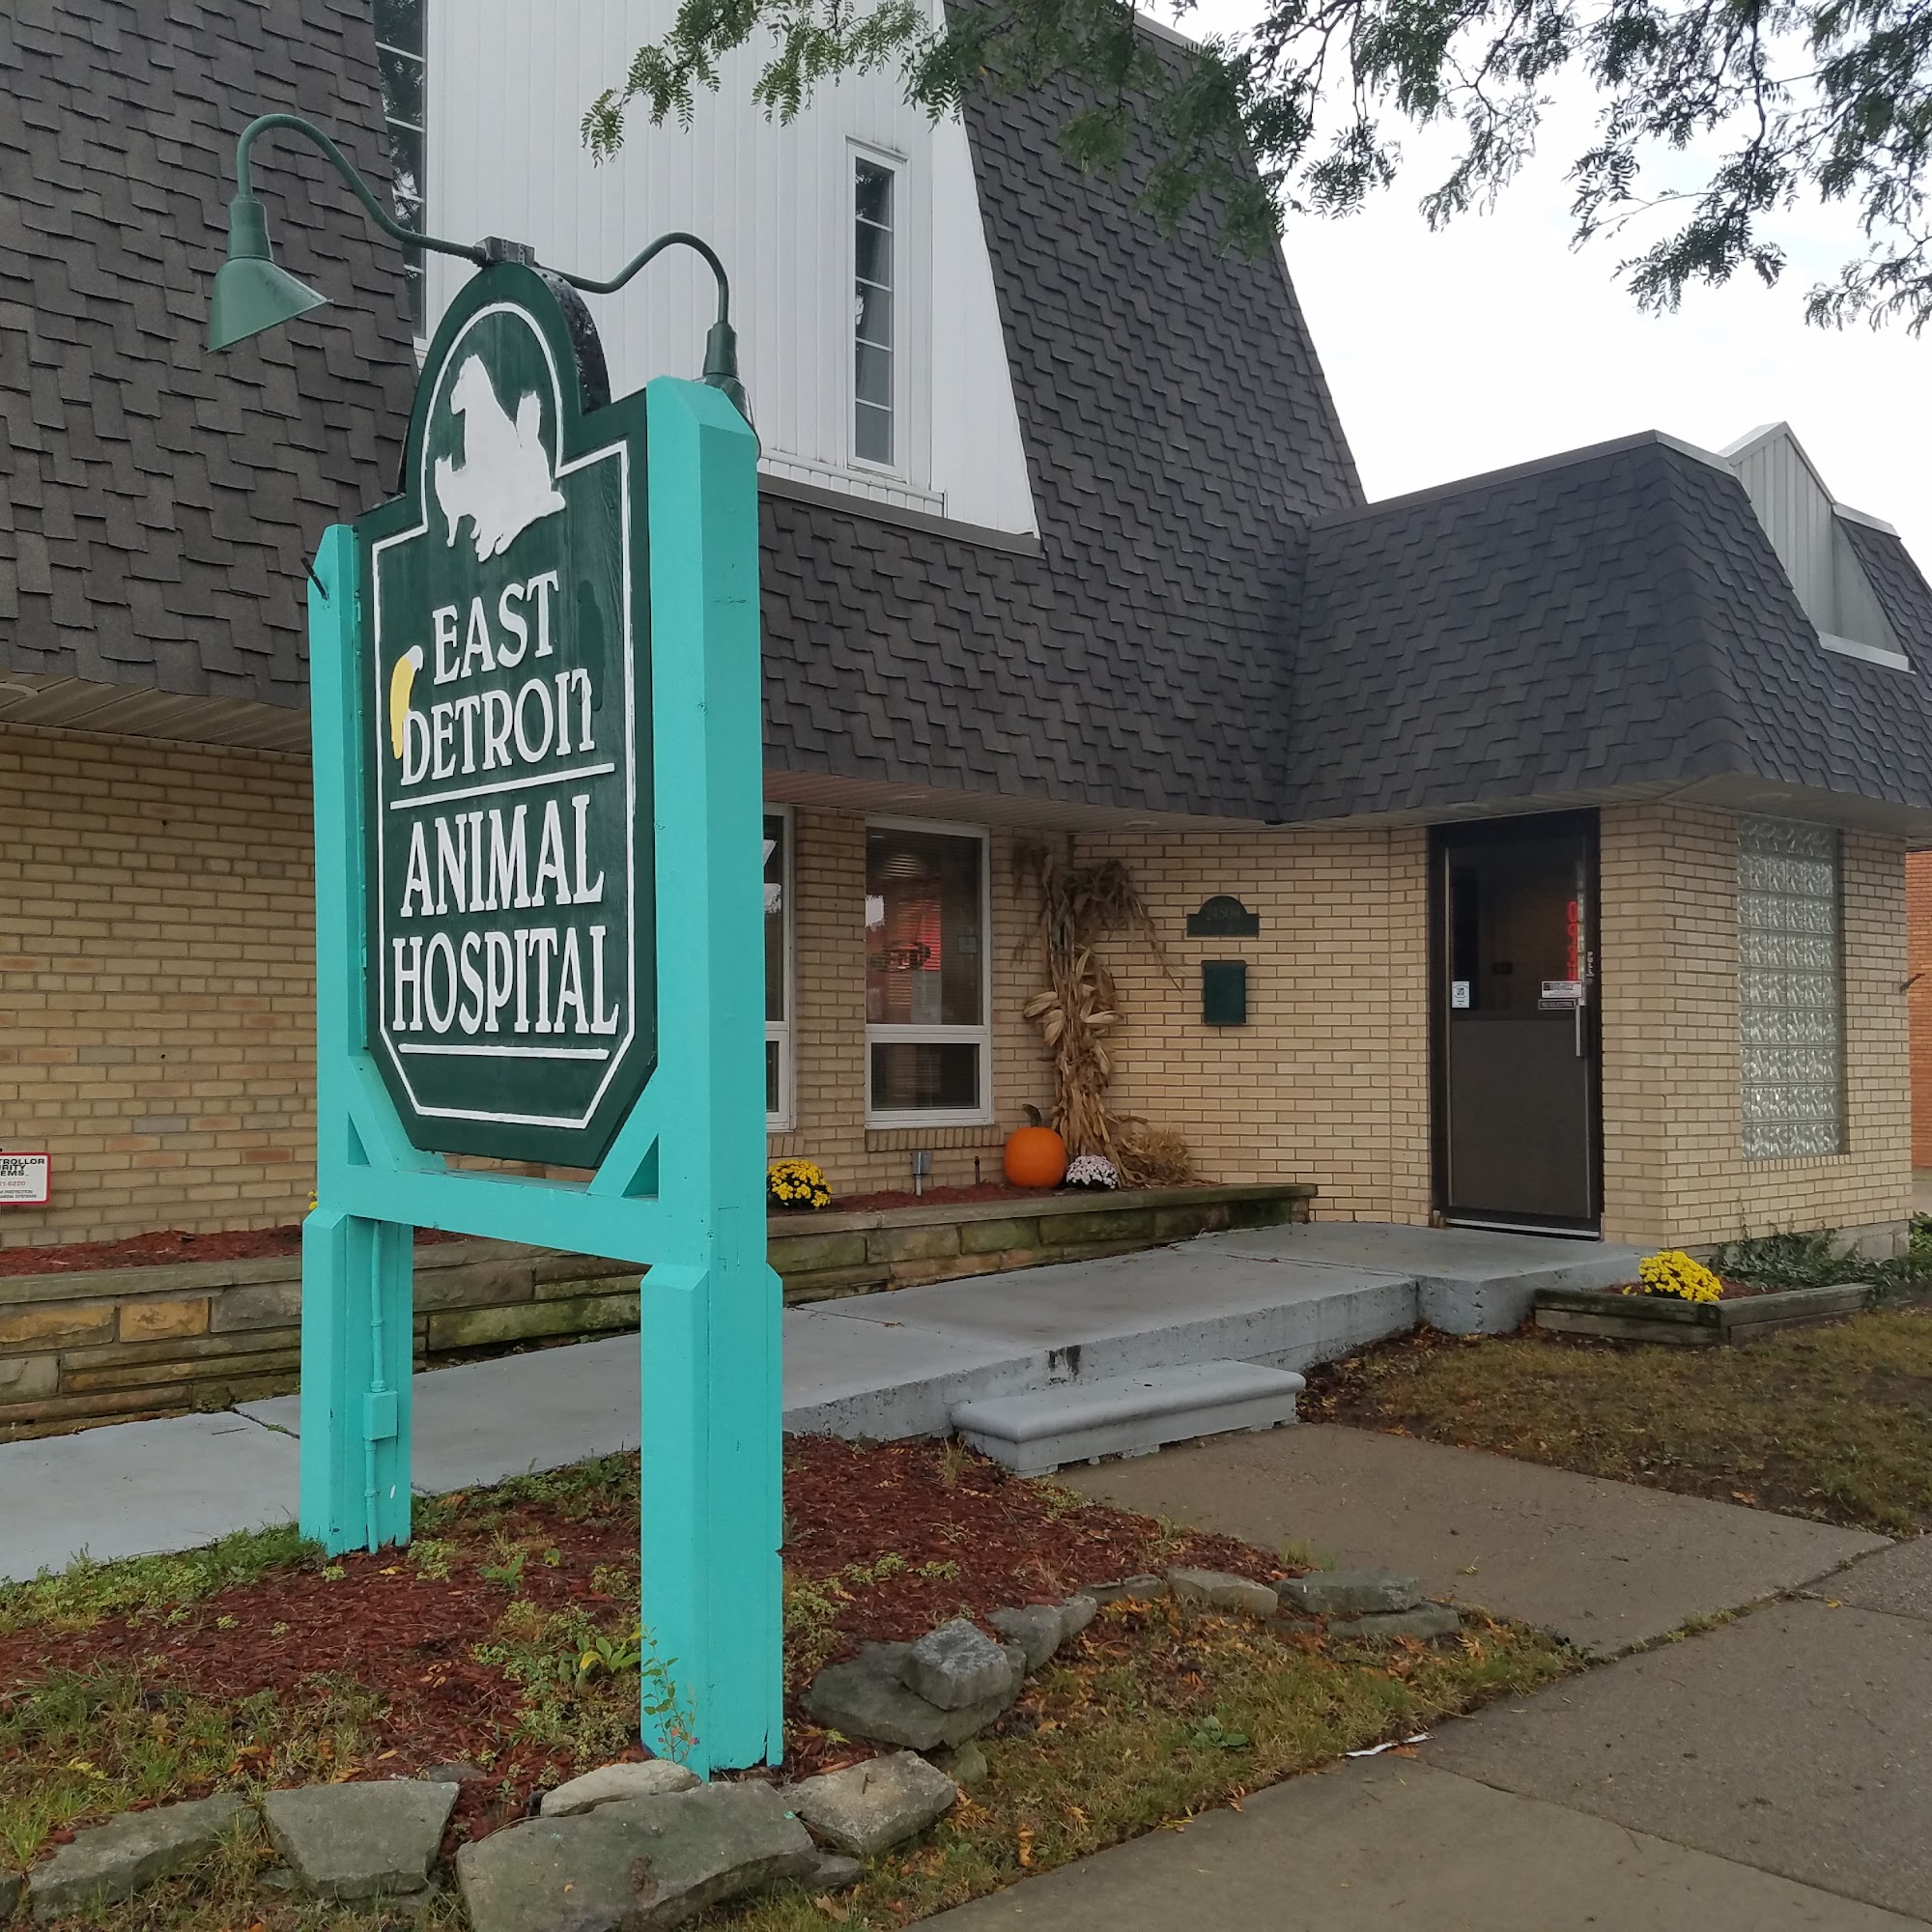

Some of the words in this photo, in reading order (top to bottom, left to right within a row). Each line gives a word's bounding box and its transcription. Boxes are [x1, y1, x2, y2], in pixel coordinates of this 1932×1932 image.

[433, 570, 559, 685] EAST
[400, 668, 595, 785] DETROIT
[400, 794, 605, 917] ANIMAL
[392, 925, 619, 1036] HOSPITAL
